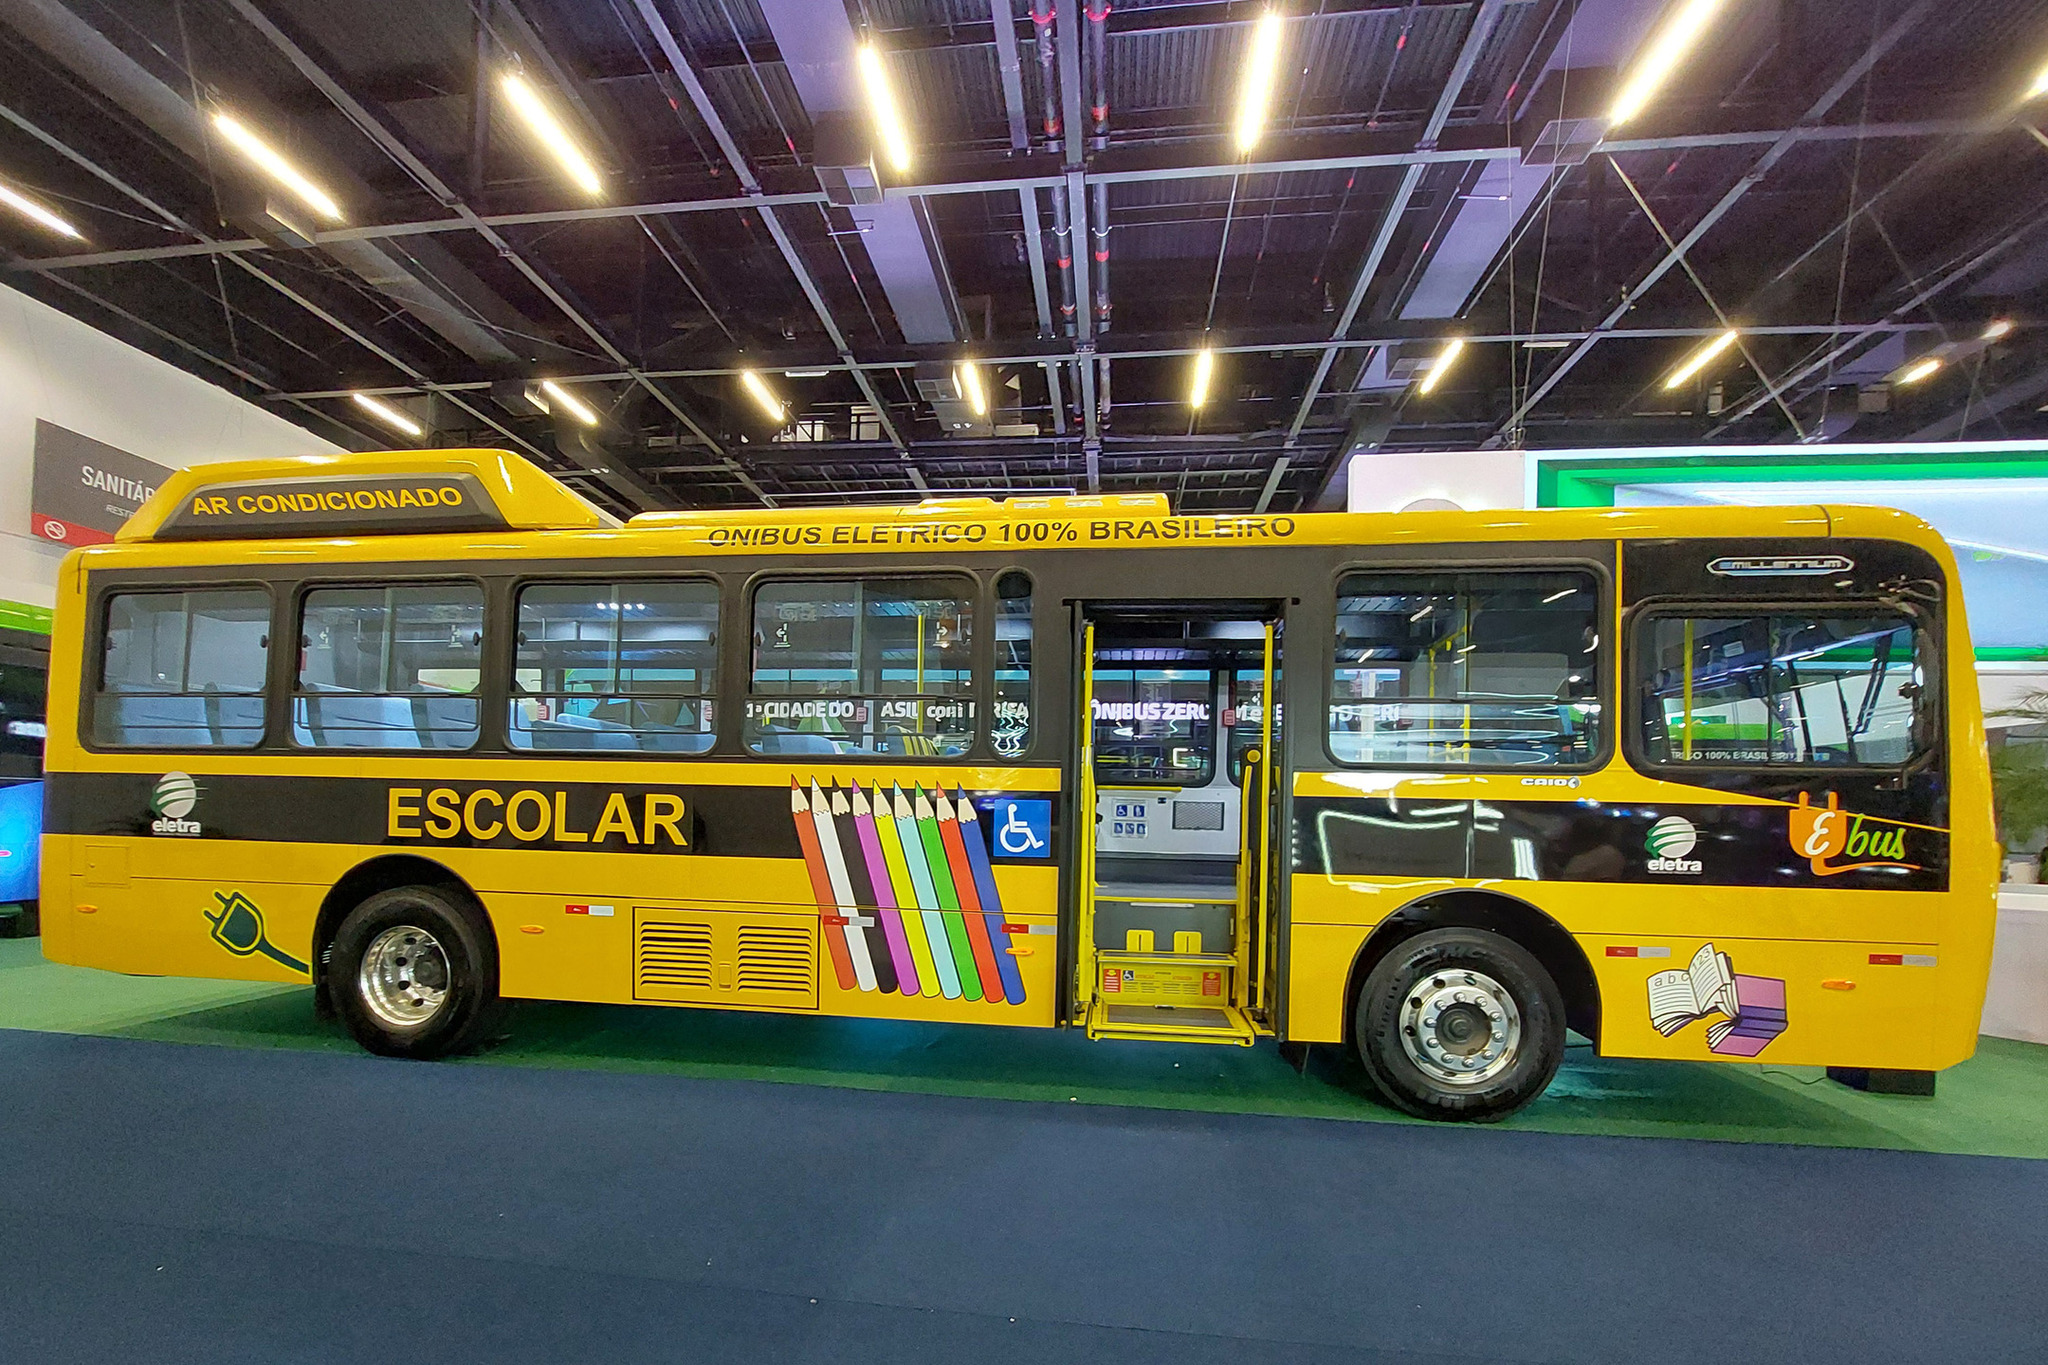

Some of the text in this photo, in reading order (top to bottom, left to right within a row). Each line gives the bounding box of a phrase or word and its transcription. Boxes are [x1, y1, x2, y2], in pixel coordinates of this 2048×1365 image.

[192, 486, 463, 515] AR CONDICIONADO
[998, 521, 1078, 542] 100%
[1090, 517, 1295, 541] BRASILEIRO
[763, 702, 826, 718] CIDADE
[828, 701, 855, 718] DO
[1520, 777, 1568, 787] CAIO
[151, 816, 202, 833] eletra
[387, 787, 689, 846] ESCOLAR
[1647, 857, 1703, 873] eletra
